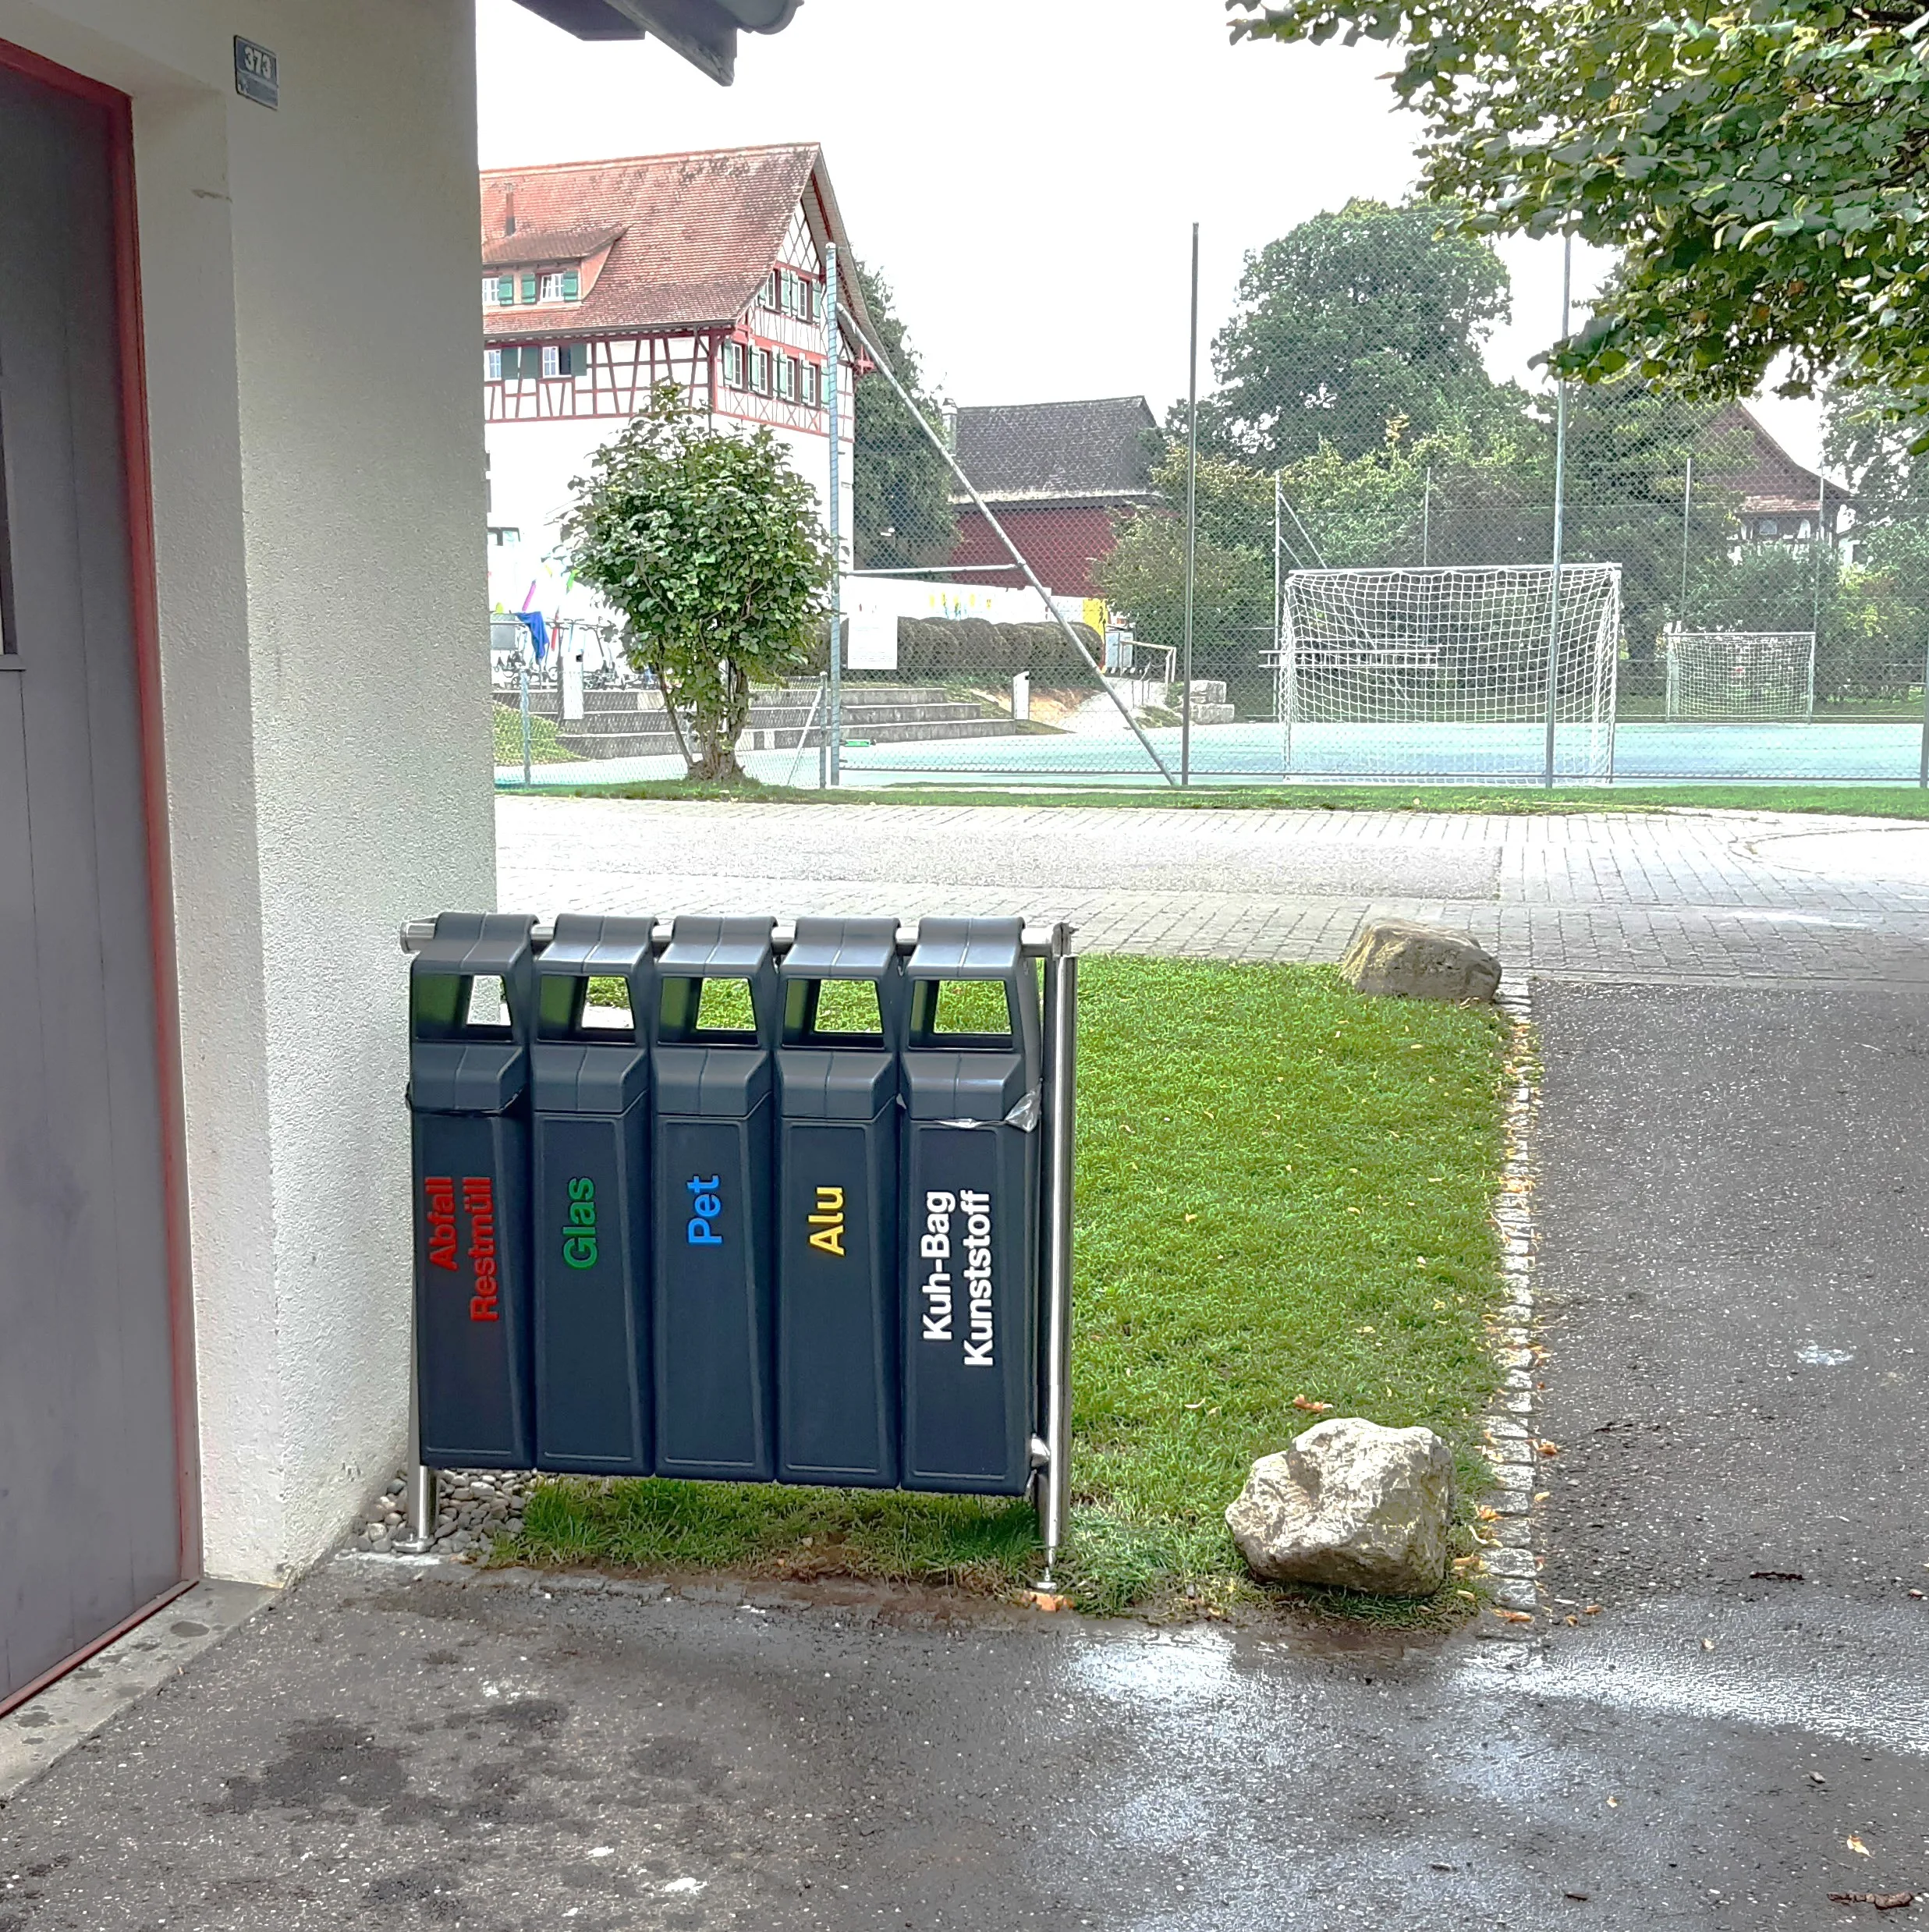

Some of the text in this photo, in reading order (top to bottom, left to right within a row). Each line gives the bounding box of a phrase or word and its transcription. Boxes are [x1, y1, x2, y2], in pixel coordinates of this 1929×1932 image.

[245, 47, 271, 79] 373
[425, 1176, 459, 1271] Abfall
[463, 1176, 500, 1322] Restmüll
[562, 1176, 598, 1270] Glas
[686, 1175, 724, 1246] Pet
[808, 1186, 845, 1256] Alu
[921, 1191, 956, 1341] Kuh-Bag
[960, 1189, 994, 1366] Kunststoff
